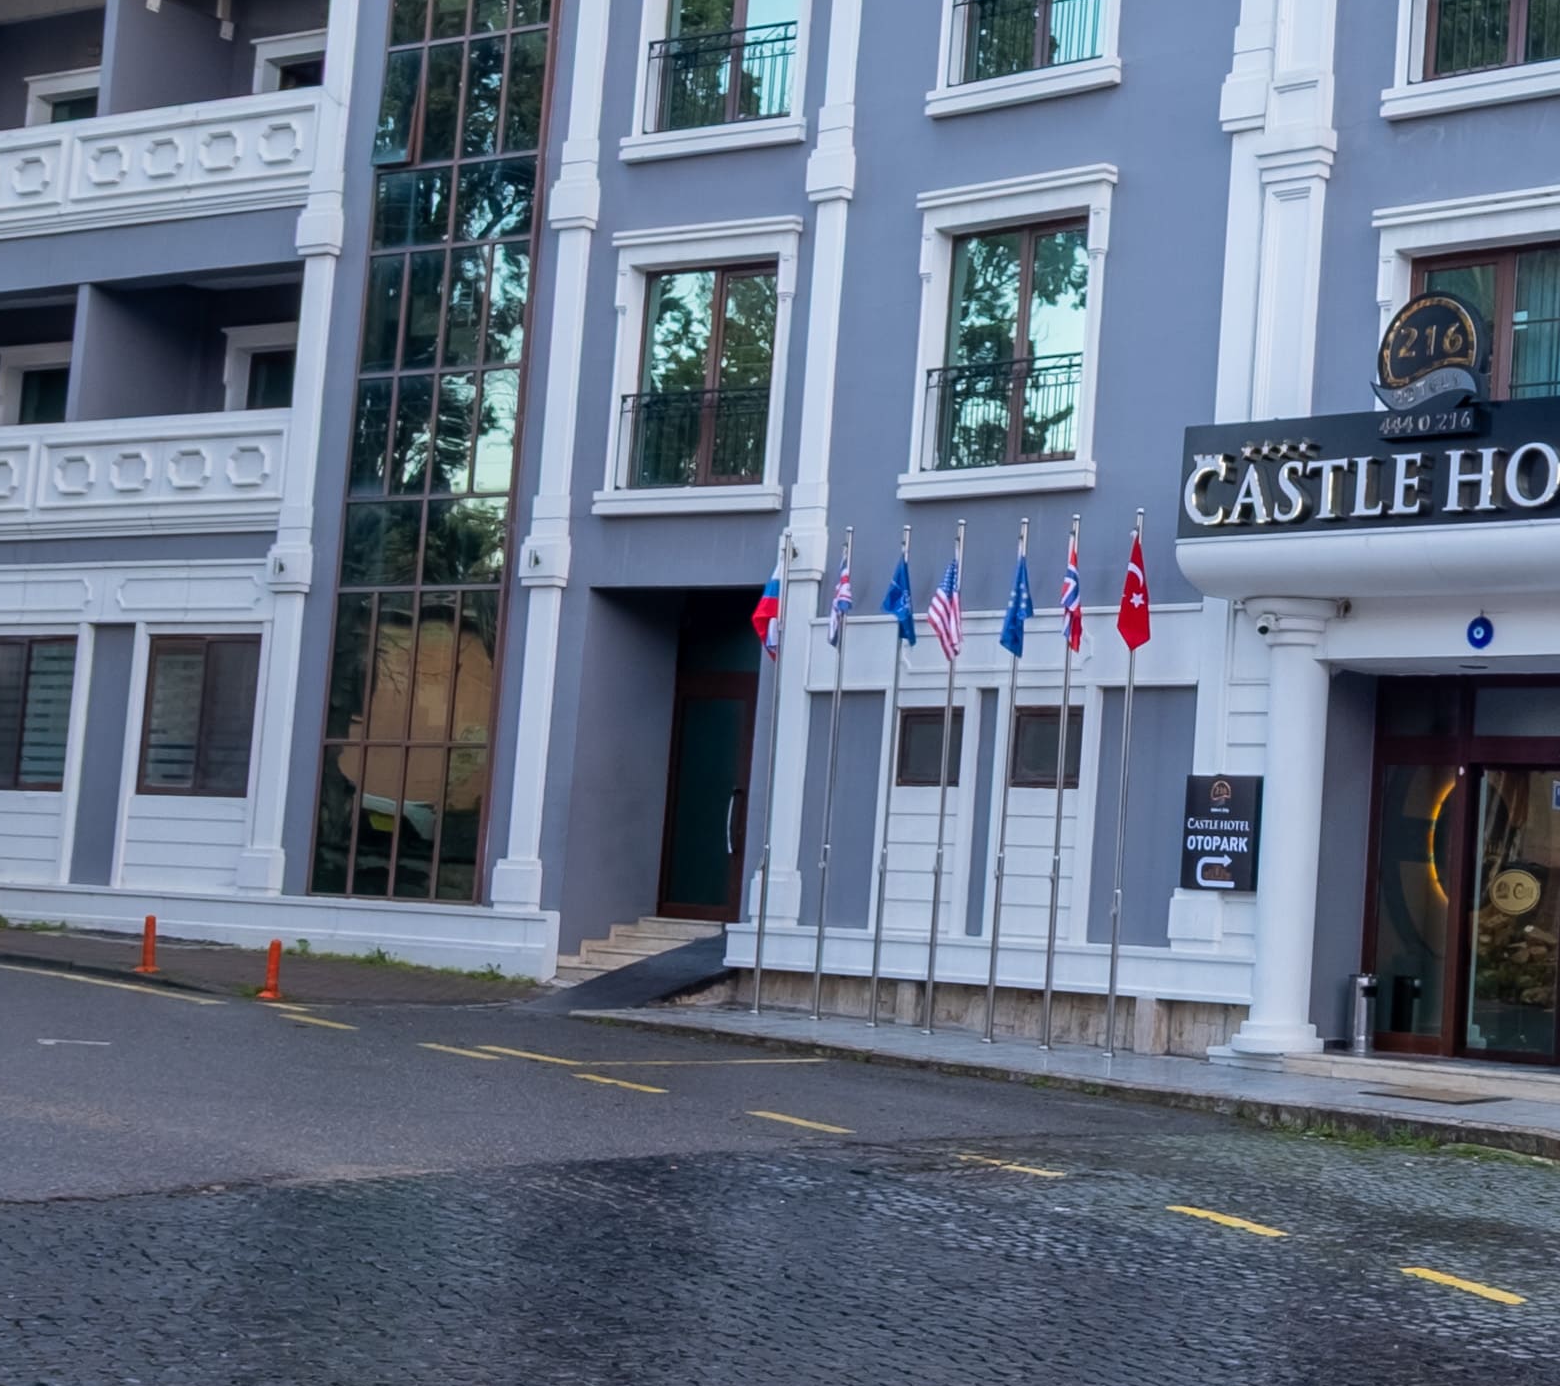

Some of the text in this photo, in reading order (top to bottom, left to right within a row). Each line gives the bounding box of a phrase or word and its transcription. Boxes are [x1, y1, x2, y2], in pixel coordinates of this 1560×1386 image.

[1398, 322, 1464, 358] 216
[1379, 415, 1414, 435] 444
[1435, 411, 1472, 431] 216
[1184, 452, 1424, 525] CASTLE
[1187, 817, 1250, 832] CASTLE HOTEL
[1187, 835, 1249, 853] OTOPARK
